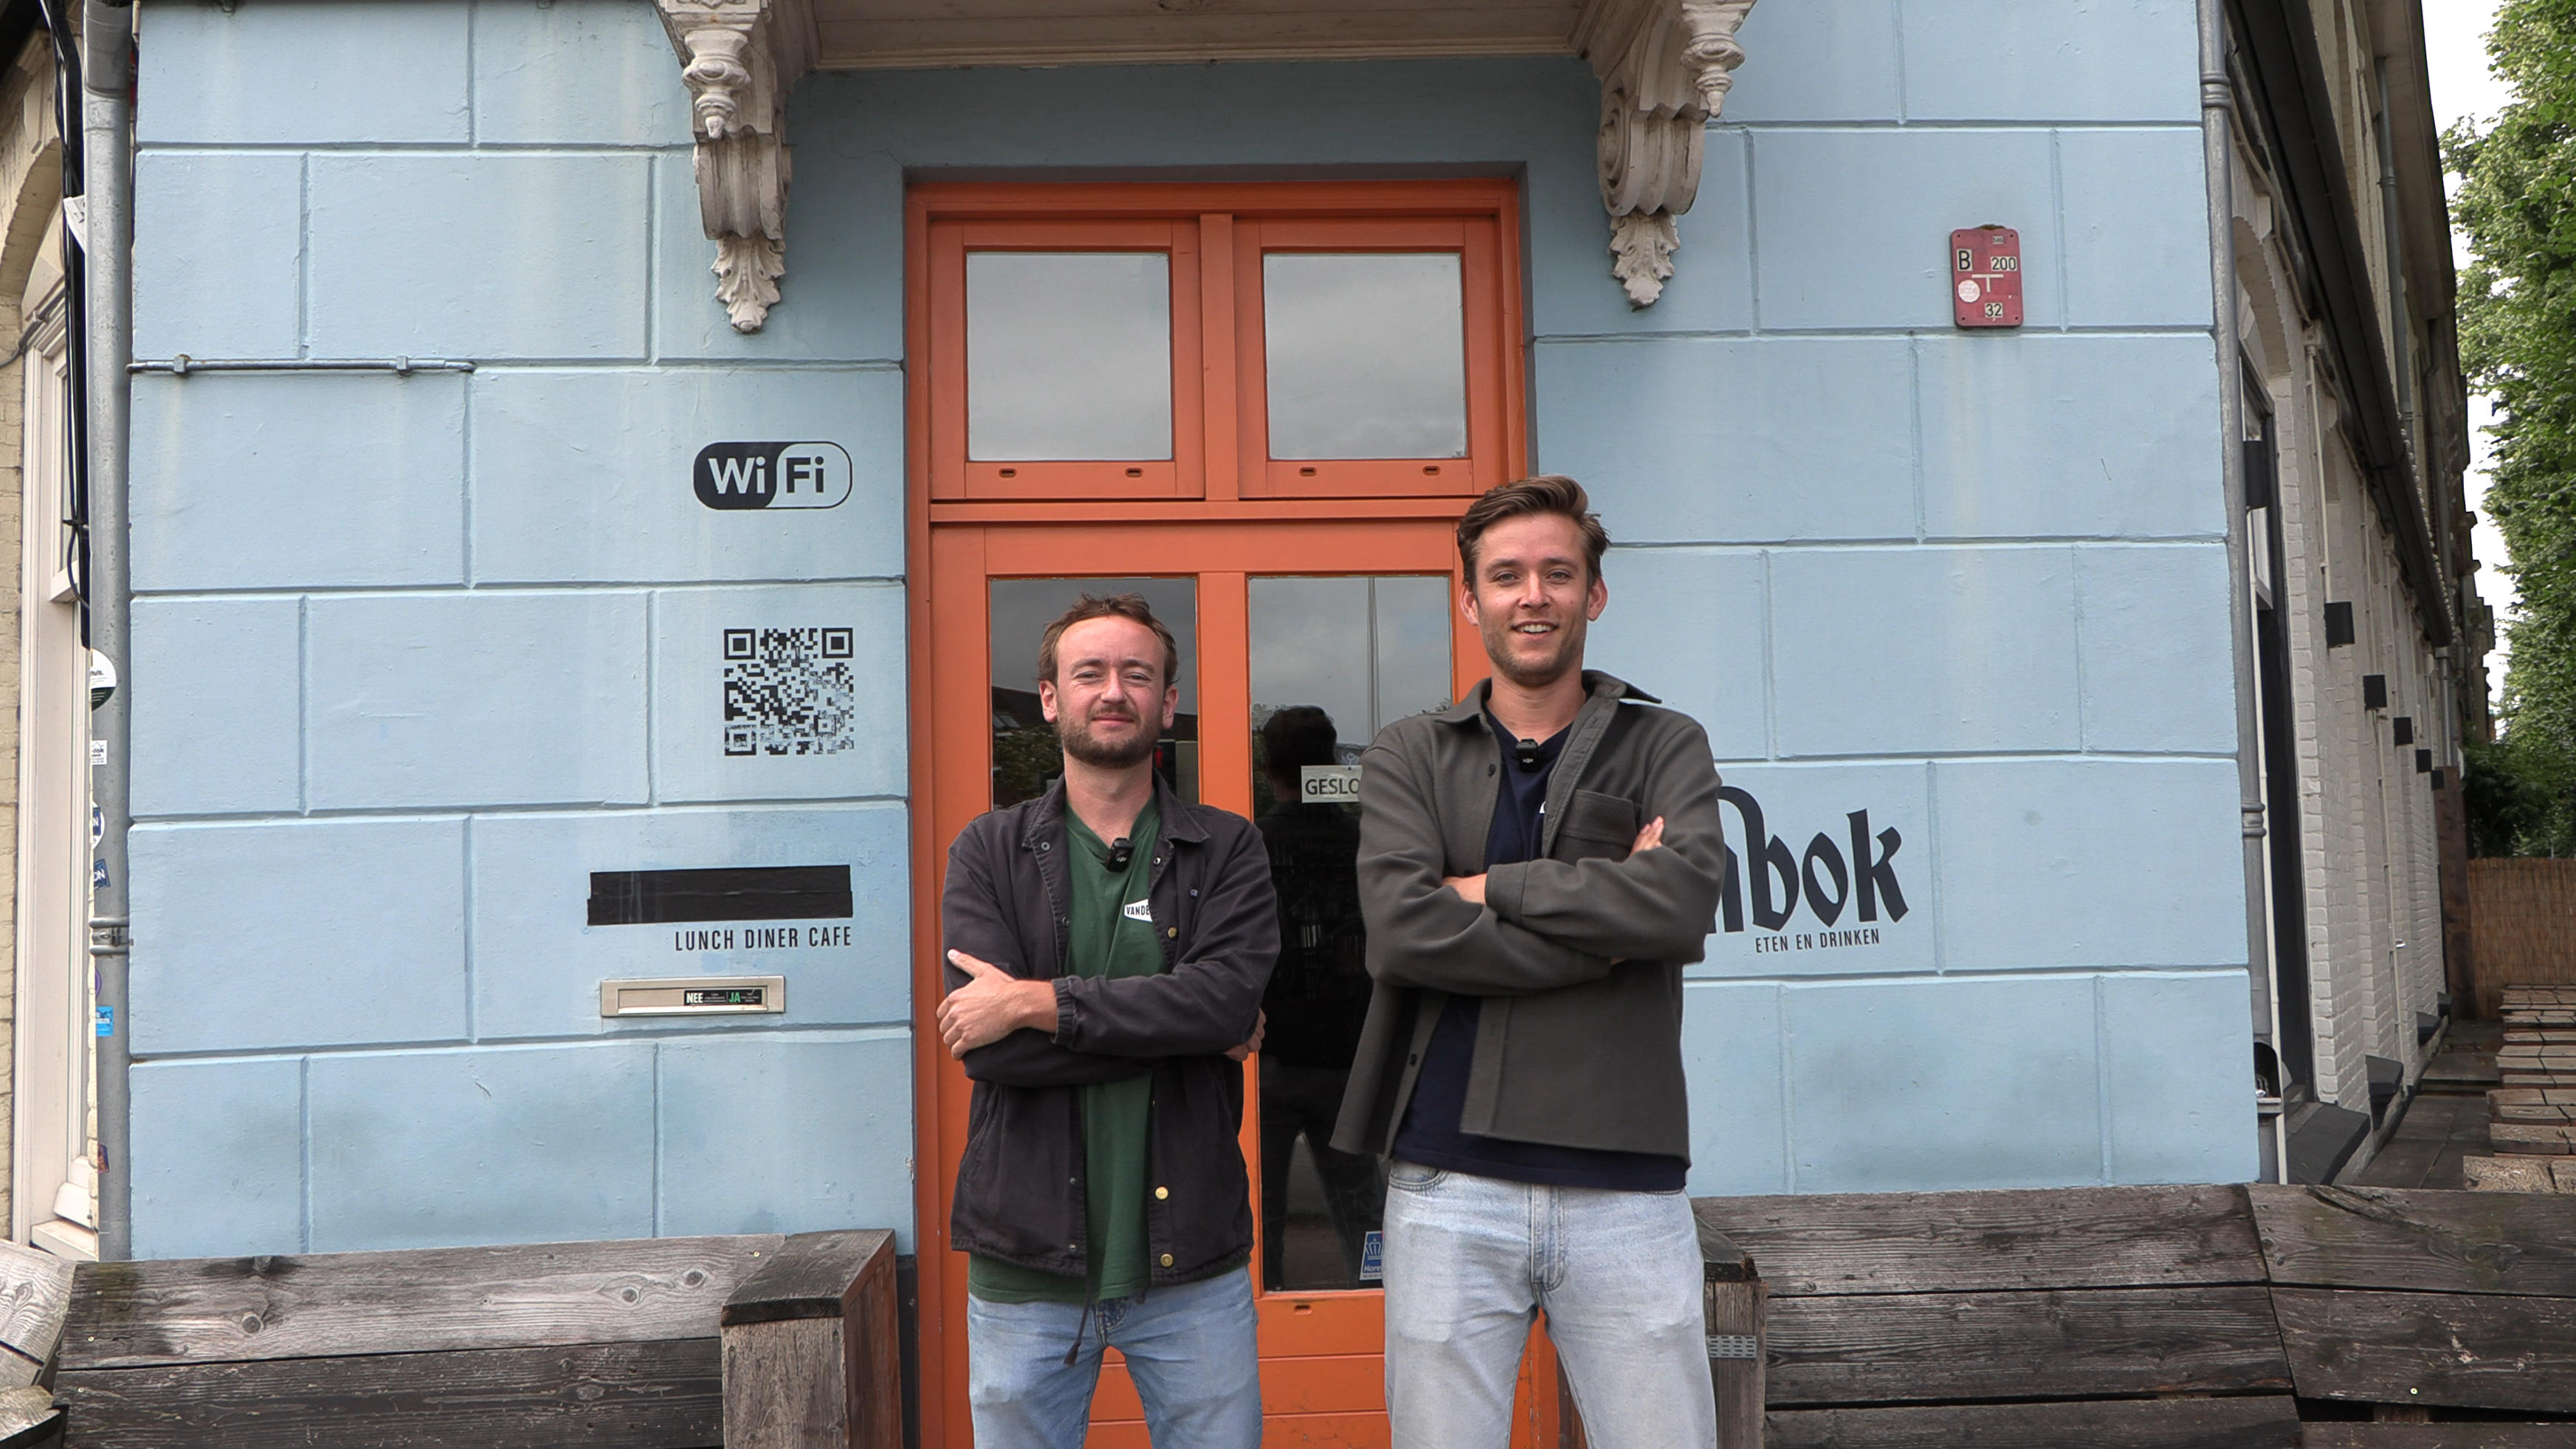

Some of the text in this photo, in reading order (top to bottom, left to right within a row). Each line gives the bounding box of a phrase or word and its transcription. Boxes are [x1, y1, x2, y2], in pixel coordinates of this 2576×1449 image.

[1958, 250, 1971, 270] B
[1991, 257, 2017, 271] 200
[1985, 303, 2002, 317] 32
[1305, 778, 1360, 795] GESLO
[675, 926, 851, 951] LUNCH DINER CAFE
[1755, 928, 1880, 953] ETEN EN DRINKEN
[686, 993, 703, 1003] NEE
[729, 991, 741, 1003] JA
